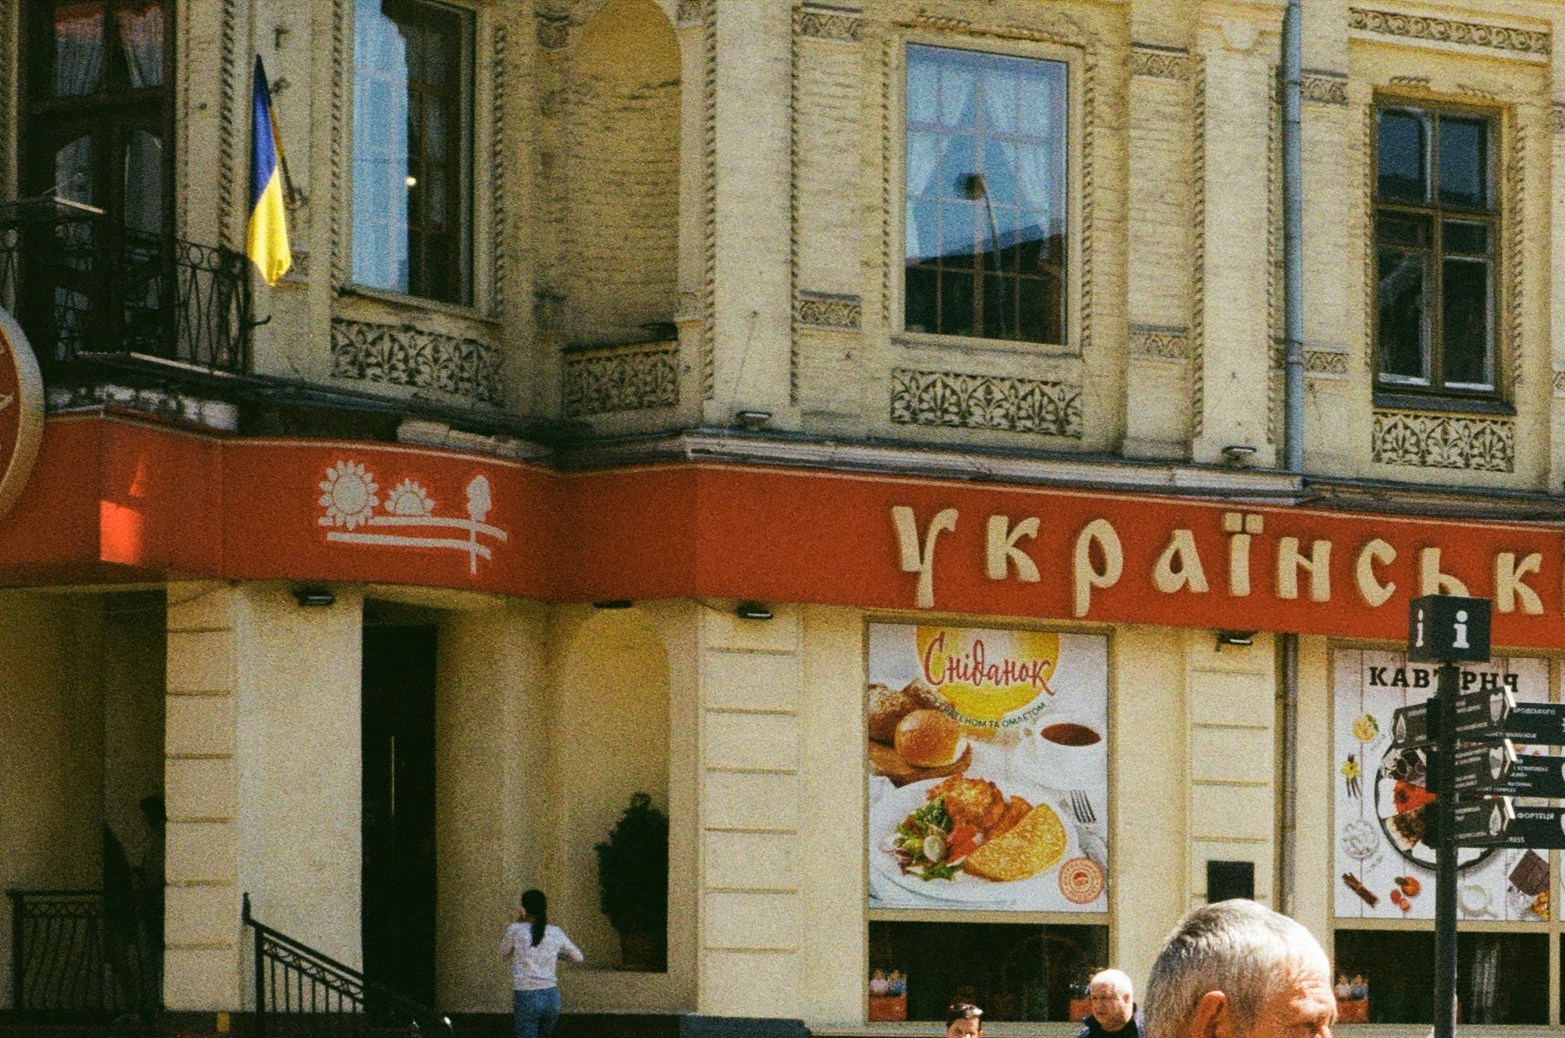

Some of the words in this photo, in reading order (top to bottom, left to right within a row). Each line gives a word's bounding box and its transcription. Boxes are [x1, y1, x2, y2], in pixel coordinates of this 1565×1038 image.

[924, 631, 1055, 697] Сніданок
[1369, 666, 1519, 692] КАВ'РНЯ
[1001, 702, 1047, 728] ОМЛЕТОМ
